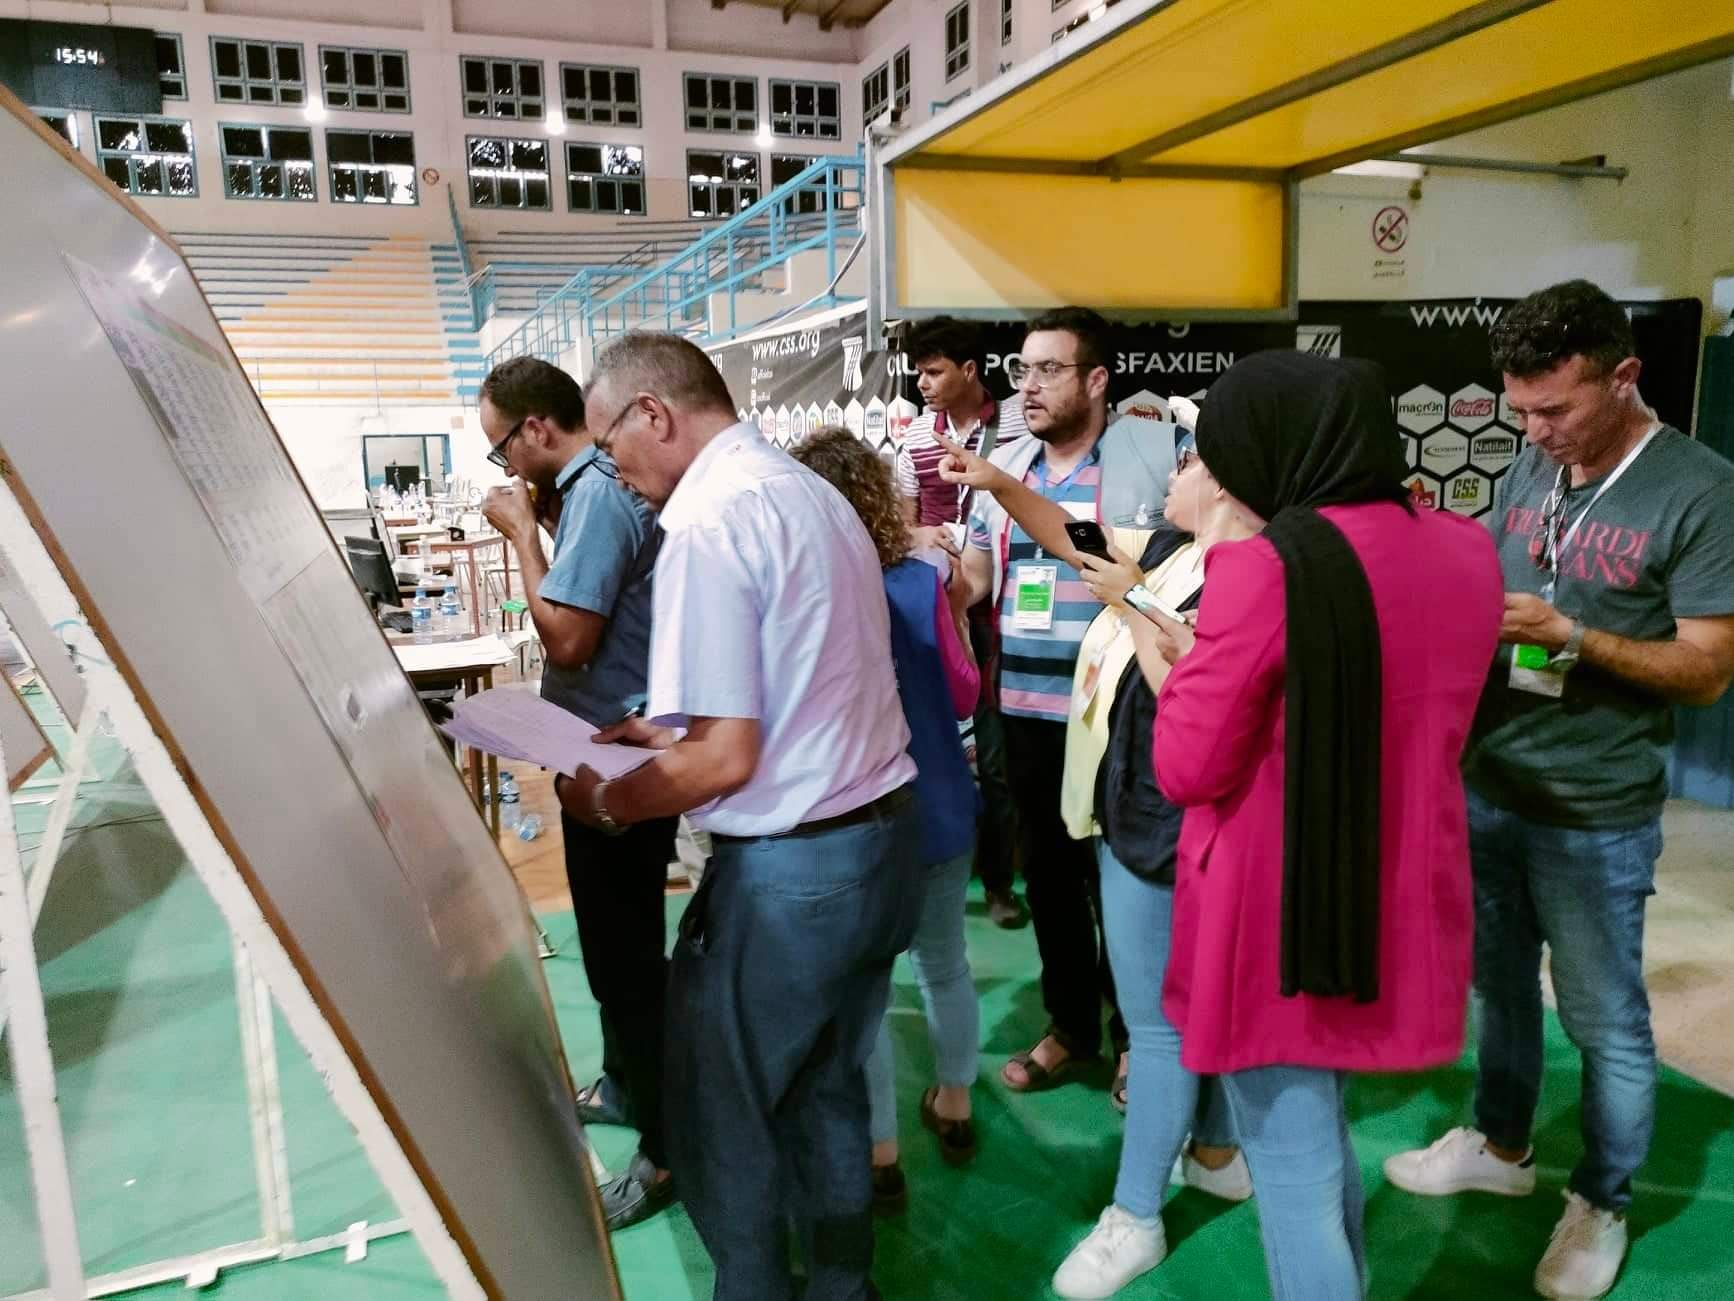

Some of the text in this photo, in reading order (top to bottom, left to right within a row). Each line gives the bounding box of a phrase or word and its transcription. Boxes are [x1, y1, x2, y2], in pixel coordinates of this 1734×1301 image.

[56, 47, 98, 65] 15:54
[752, 329, 820, 359] www.css.org
[1115, 352, 1235, 374] SFAXIEN
